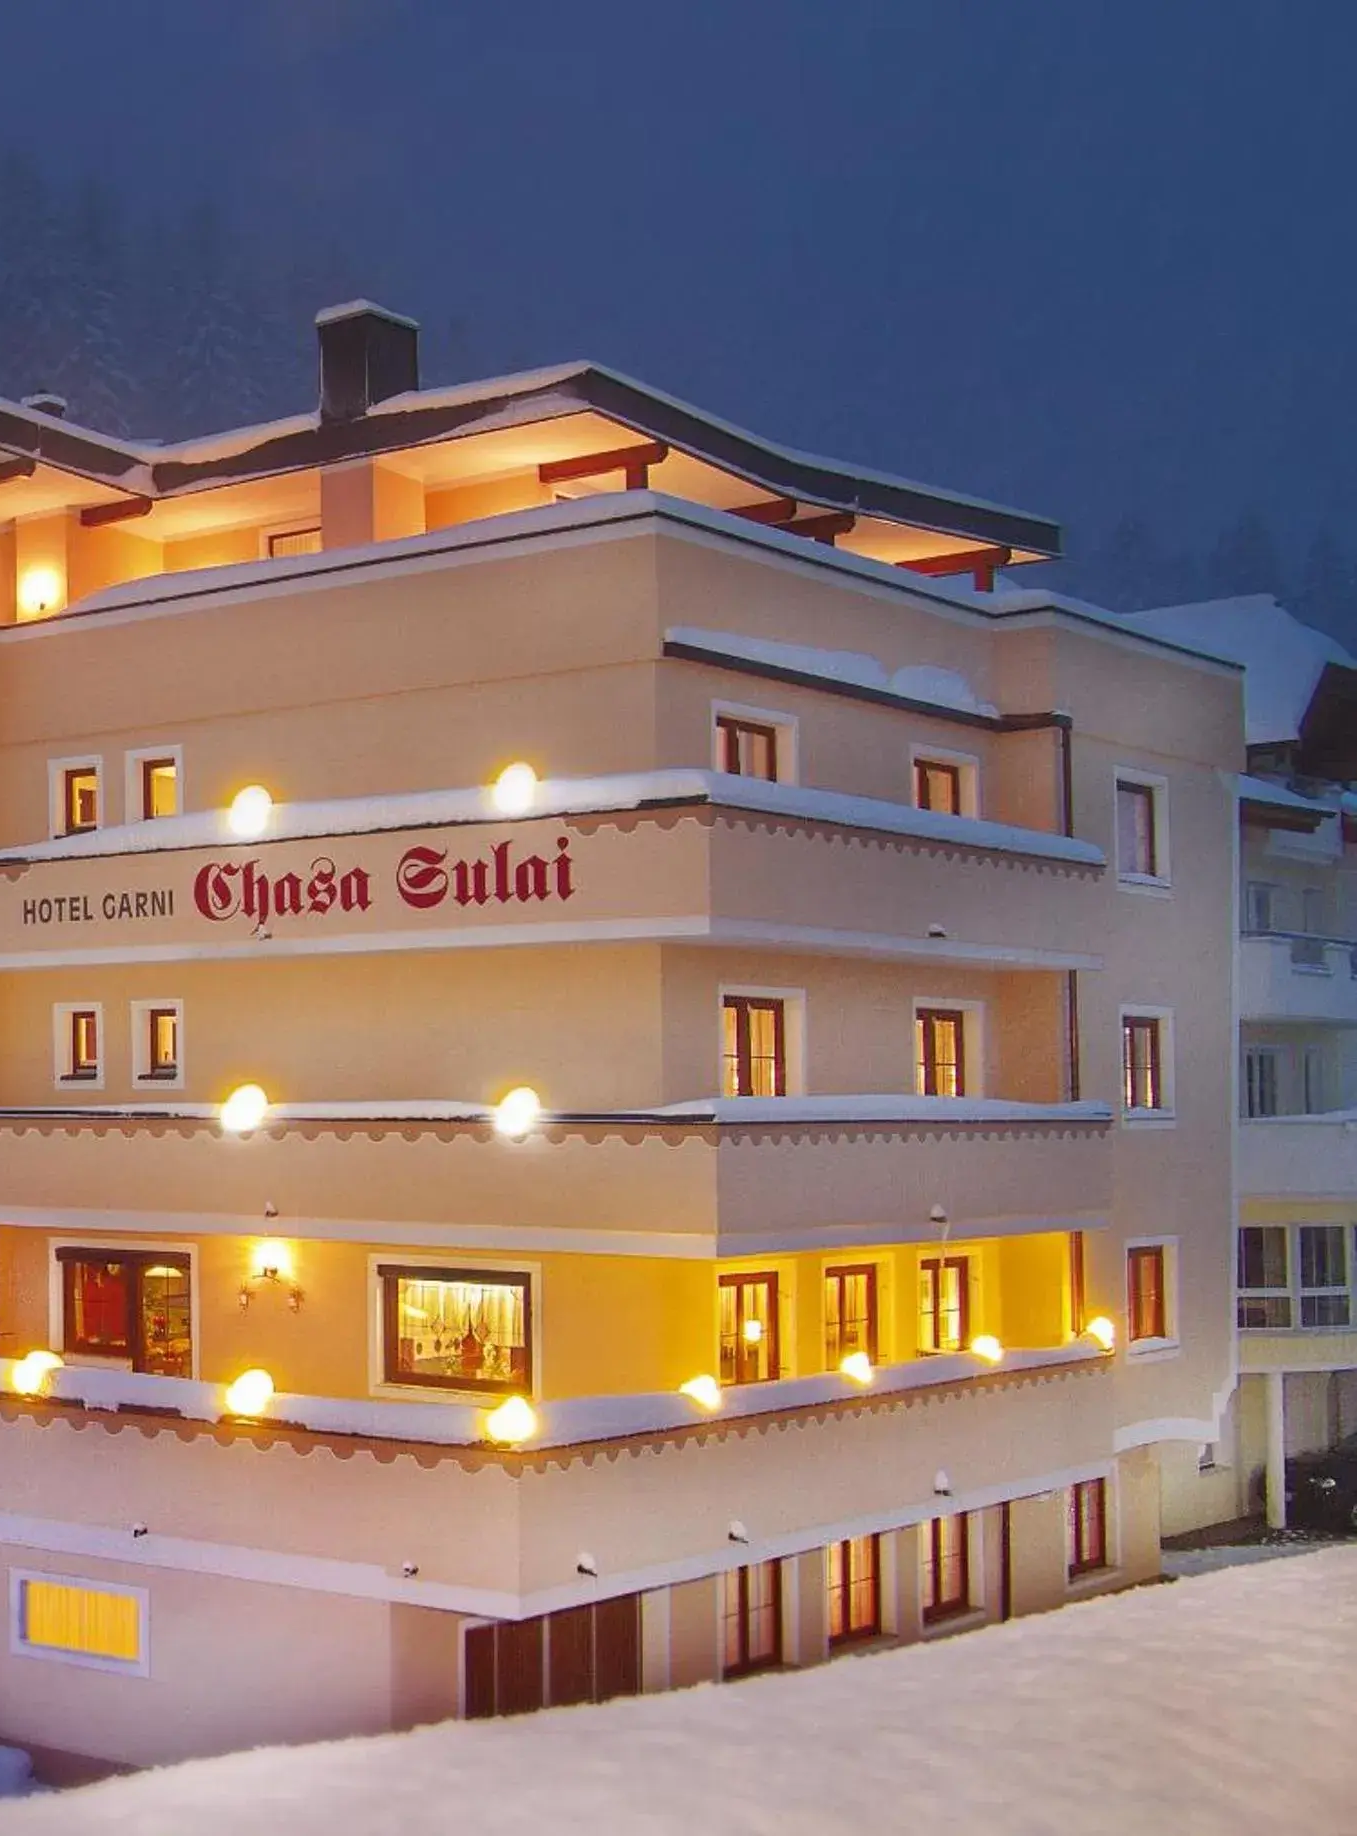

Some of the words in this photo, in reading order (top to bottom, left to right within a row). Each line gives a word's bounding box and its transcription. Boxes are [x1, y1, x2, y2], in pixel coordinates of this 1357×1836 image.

[23, 896, 93, 924] HOTEL
[102, 889, 174, 919] GARNI
[194, 856, 374, 930] Chasa
[396, 836, 576, 909] Sulai
